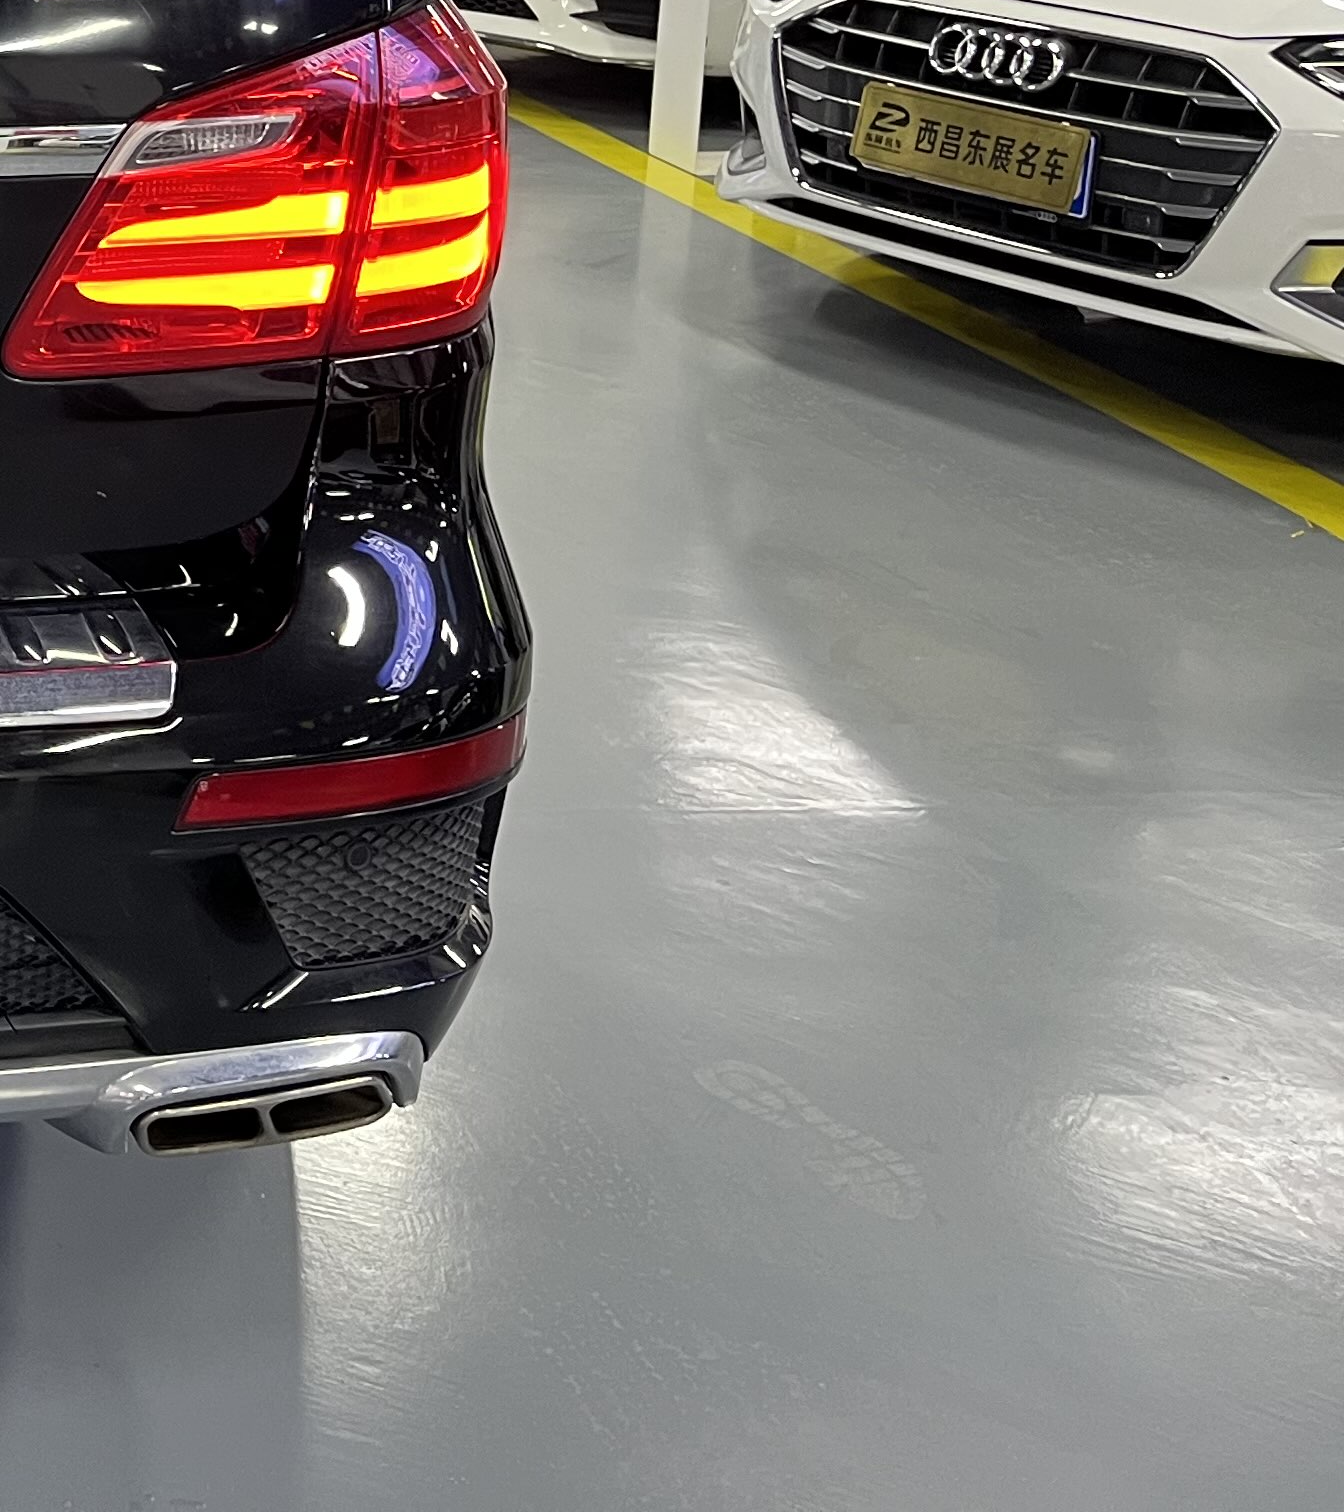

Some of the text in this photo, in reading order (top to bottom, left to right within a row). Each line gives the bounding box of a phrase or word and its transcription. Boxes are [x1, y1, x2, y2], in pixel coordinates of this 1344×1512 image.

[914, 117, 1069, 186] 西昌东展名车
